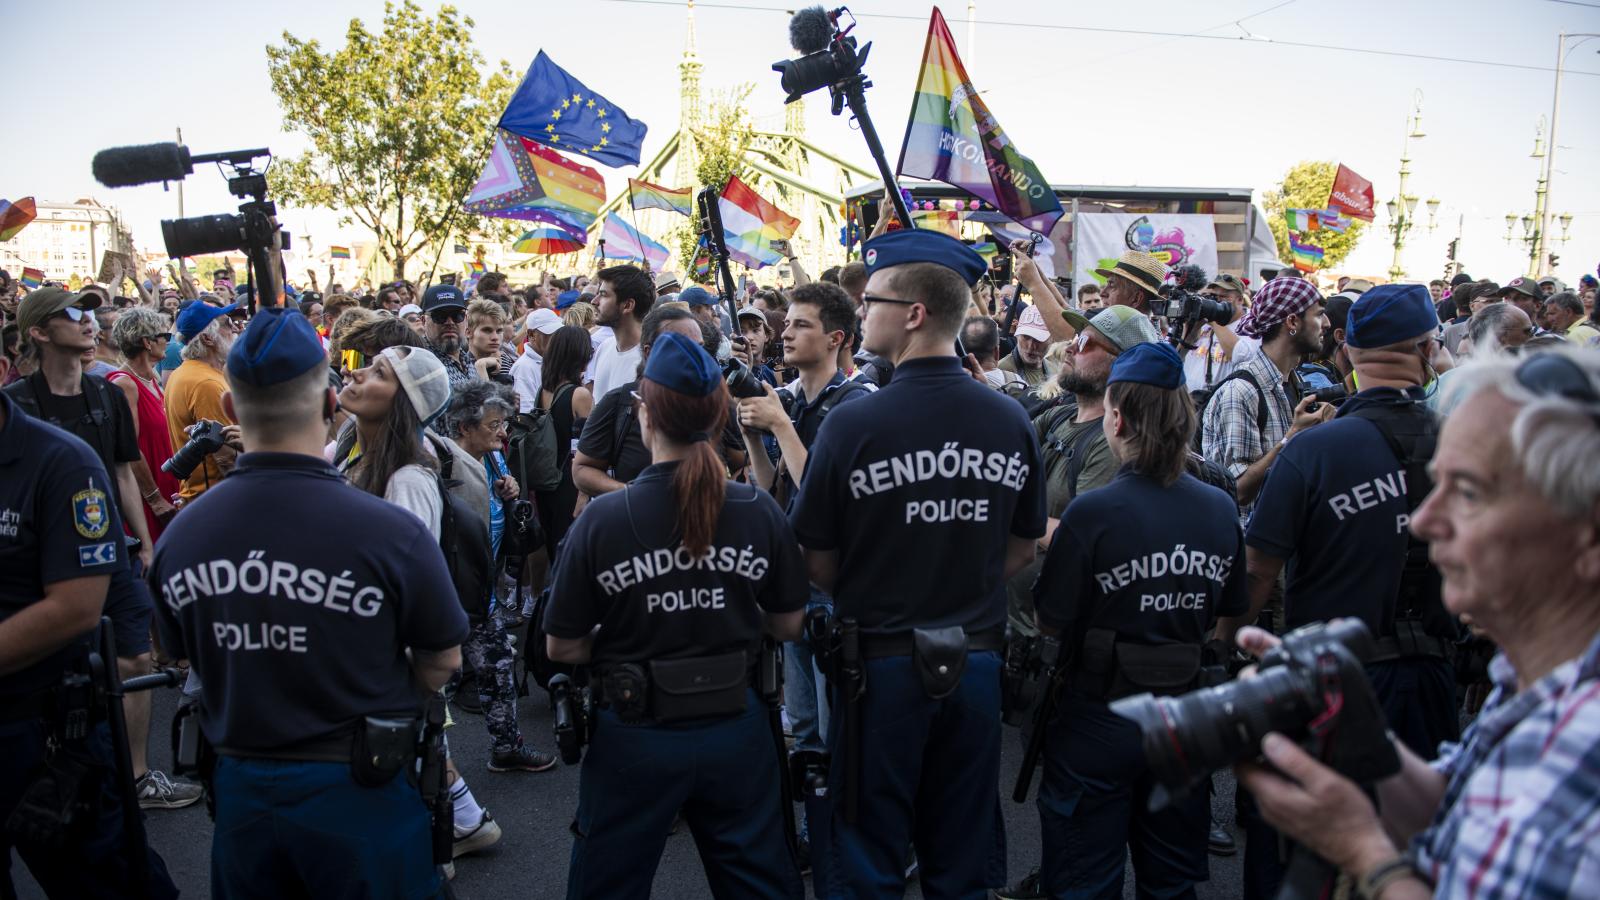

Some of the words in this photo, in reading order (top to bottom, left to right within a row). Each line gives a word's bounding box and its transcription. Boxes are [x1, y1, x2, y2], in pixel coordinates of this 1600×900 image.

[1332, 191, 1361, 209] abour
[848, 441, 1030, 500] RENDŐRSÉG
[905, 498, 989, 524] POLICE
[1094, 544, 1233, 594] RENDŐRSÉ
[162, 550, 385, 617] RENDŐRSÉG
[647, 587, 726, 613] POLICE
[1140, 592, 1206, 612] POLICE
[212, 622, 308, 652] POLICE
